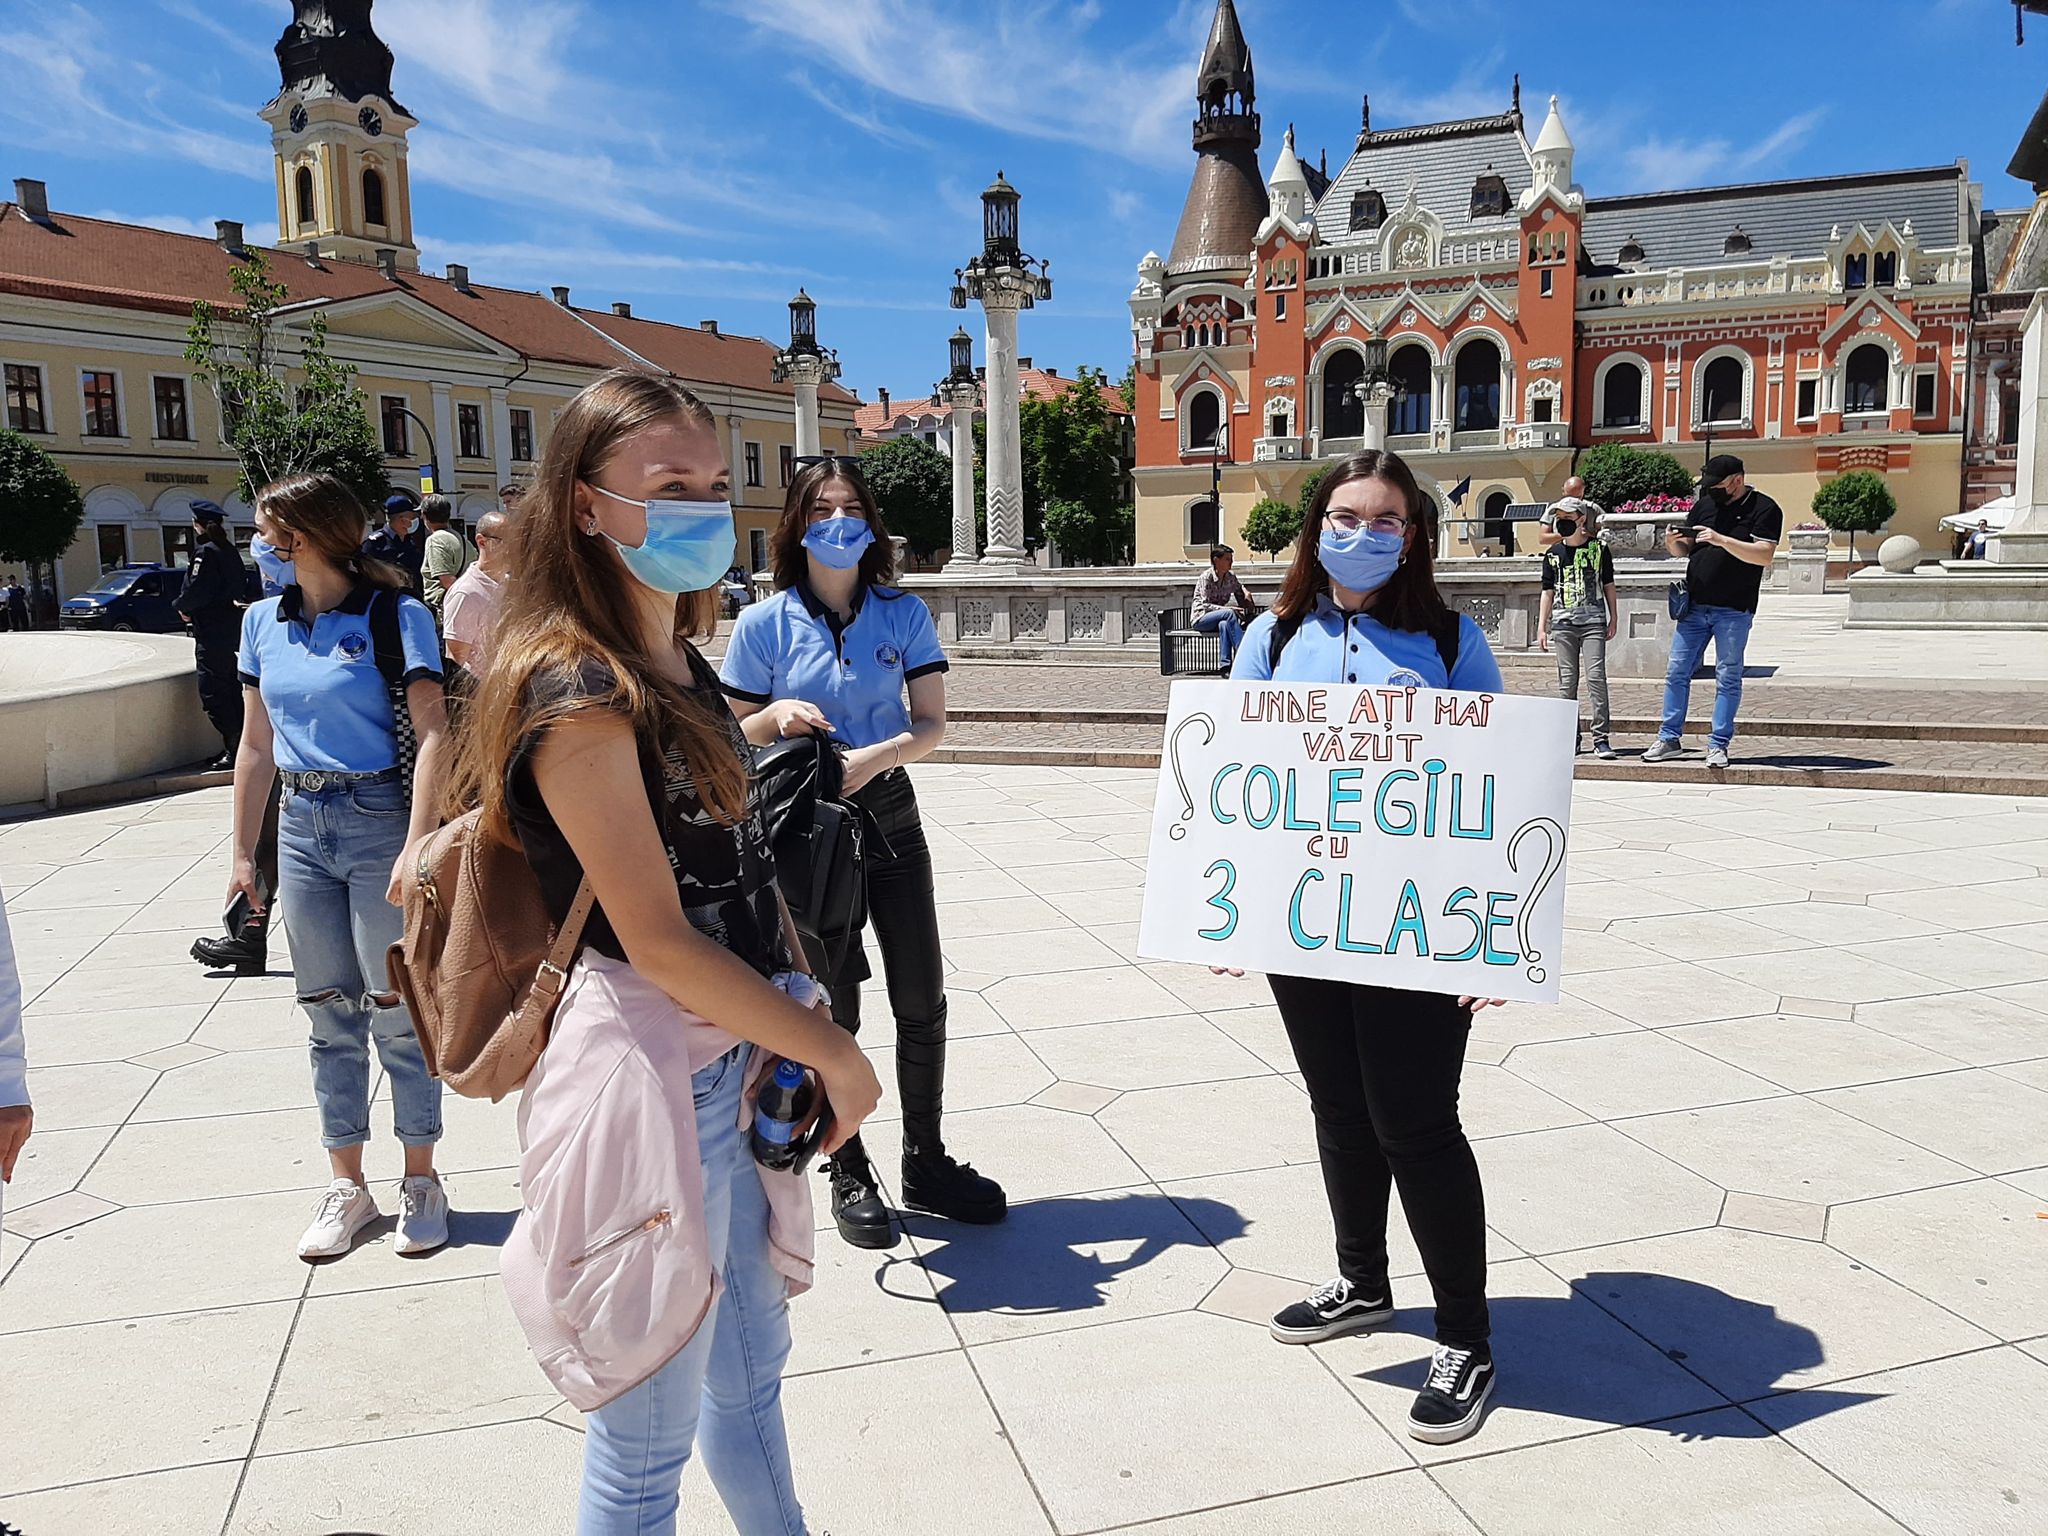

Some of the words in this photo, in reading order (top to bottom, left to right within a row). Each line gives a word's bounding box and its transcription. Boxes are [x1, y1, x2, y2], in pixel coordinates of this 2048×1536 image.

[1241, 690, 1327, 722] UNDE
[1434, 694, 1494, 727] MAI
[1210, 759, 1495, 840] COLEGIU
[1306, 836, 1349, 858] CU
[1198, 859, 1239, 941] 3
